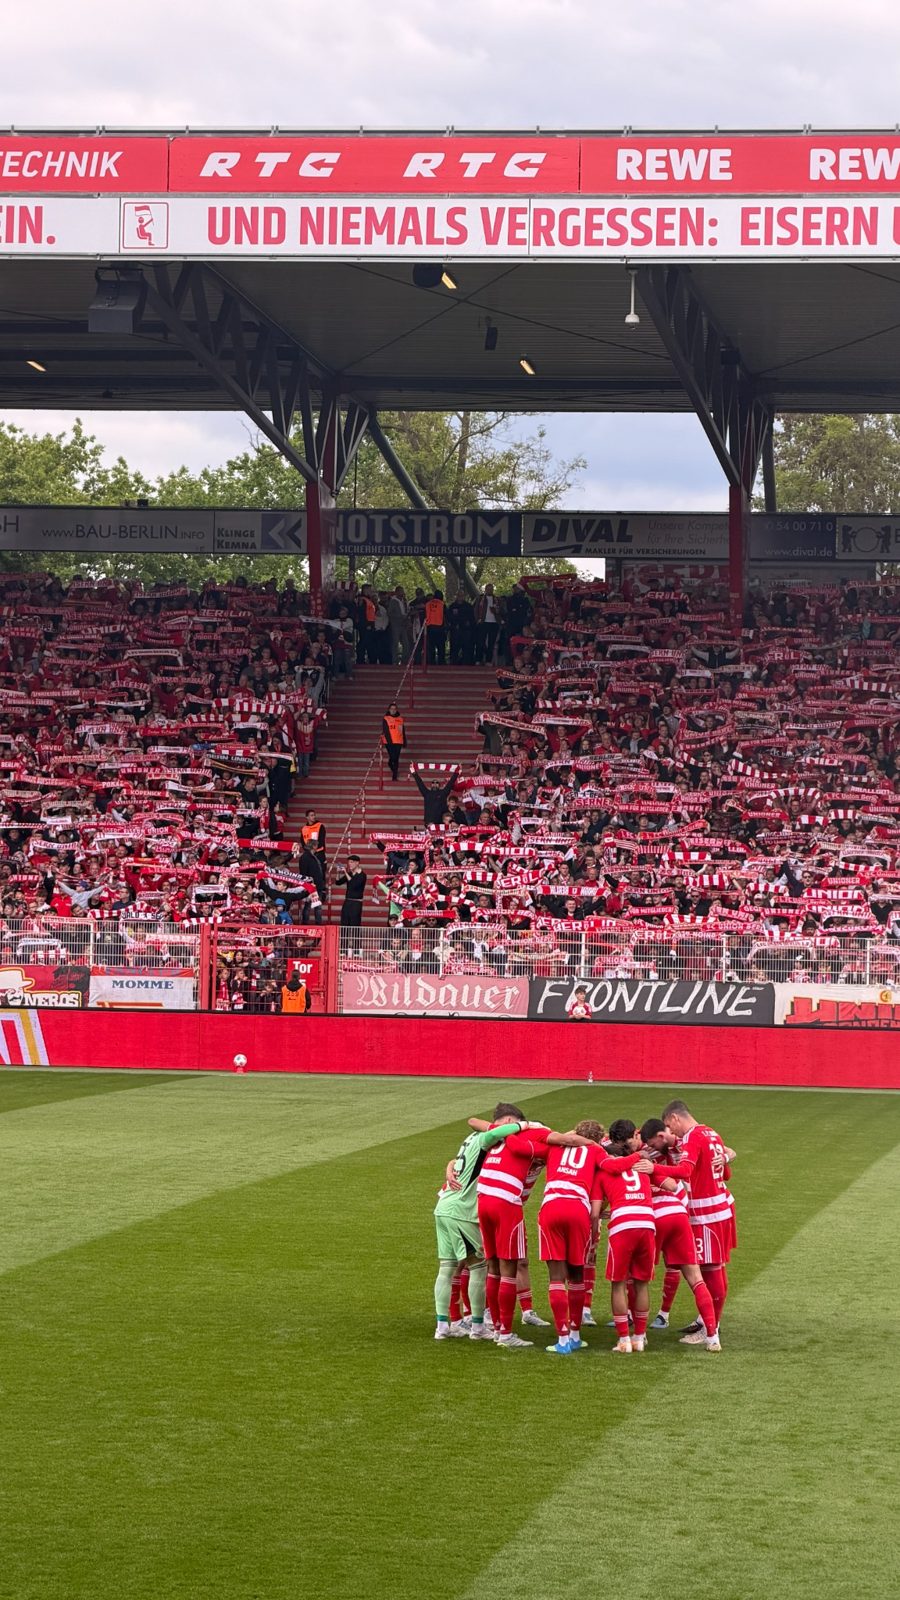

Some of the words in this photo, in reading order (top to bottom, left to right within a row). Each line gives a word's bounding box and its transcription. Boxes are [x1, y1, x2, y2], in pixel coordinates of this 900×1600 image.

[0, 151, 124, 177] ECHNIK
[616, 148, 733, 180] REWE
[0, 205, 56, 244] IN.
[207, 206, 286, 245] UND
[299, 206, 468, 245] NIEMALS
[480, 207, 718, 247] VERGESSEN:
[740, 206, 879, 246] EISERN
[0, 515, 19, 533] H
[217, 527, 255, 538] KLINGE
[532, 518, 633, 543] DIVAL
[217, 540, 257, 550] KEMNA
[250, 839, 279, 849] UNIONER
[292, 960, 313, 974] Tor
[111, 979, 175, 990] MOMME
[537, 980, 765, 1017] FRONTLINE
[560, 1145, 588, 1169] 10
[622, 1169, 641, 1192] 9
